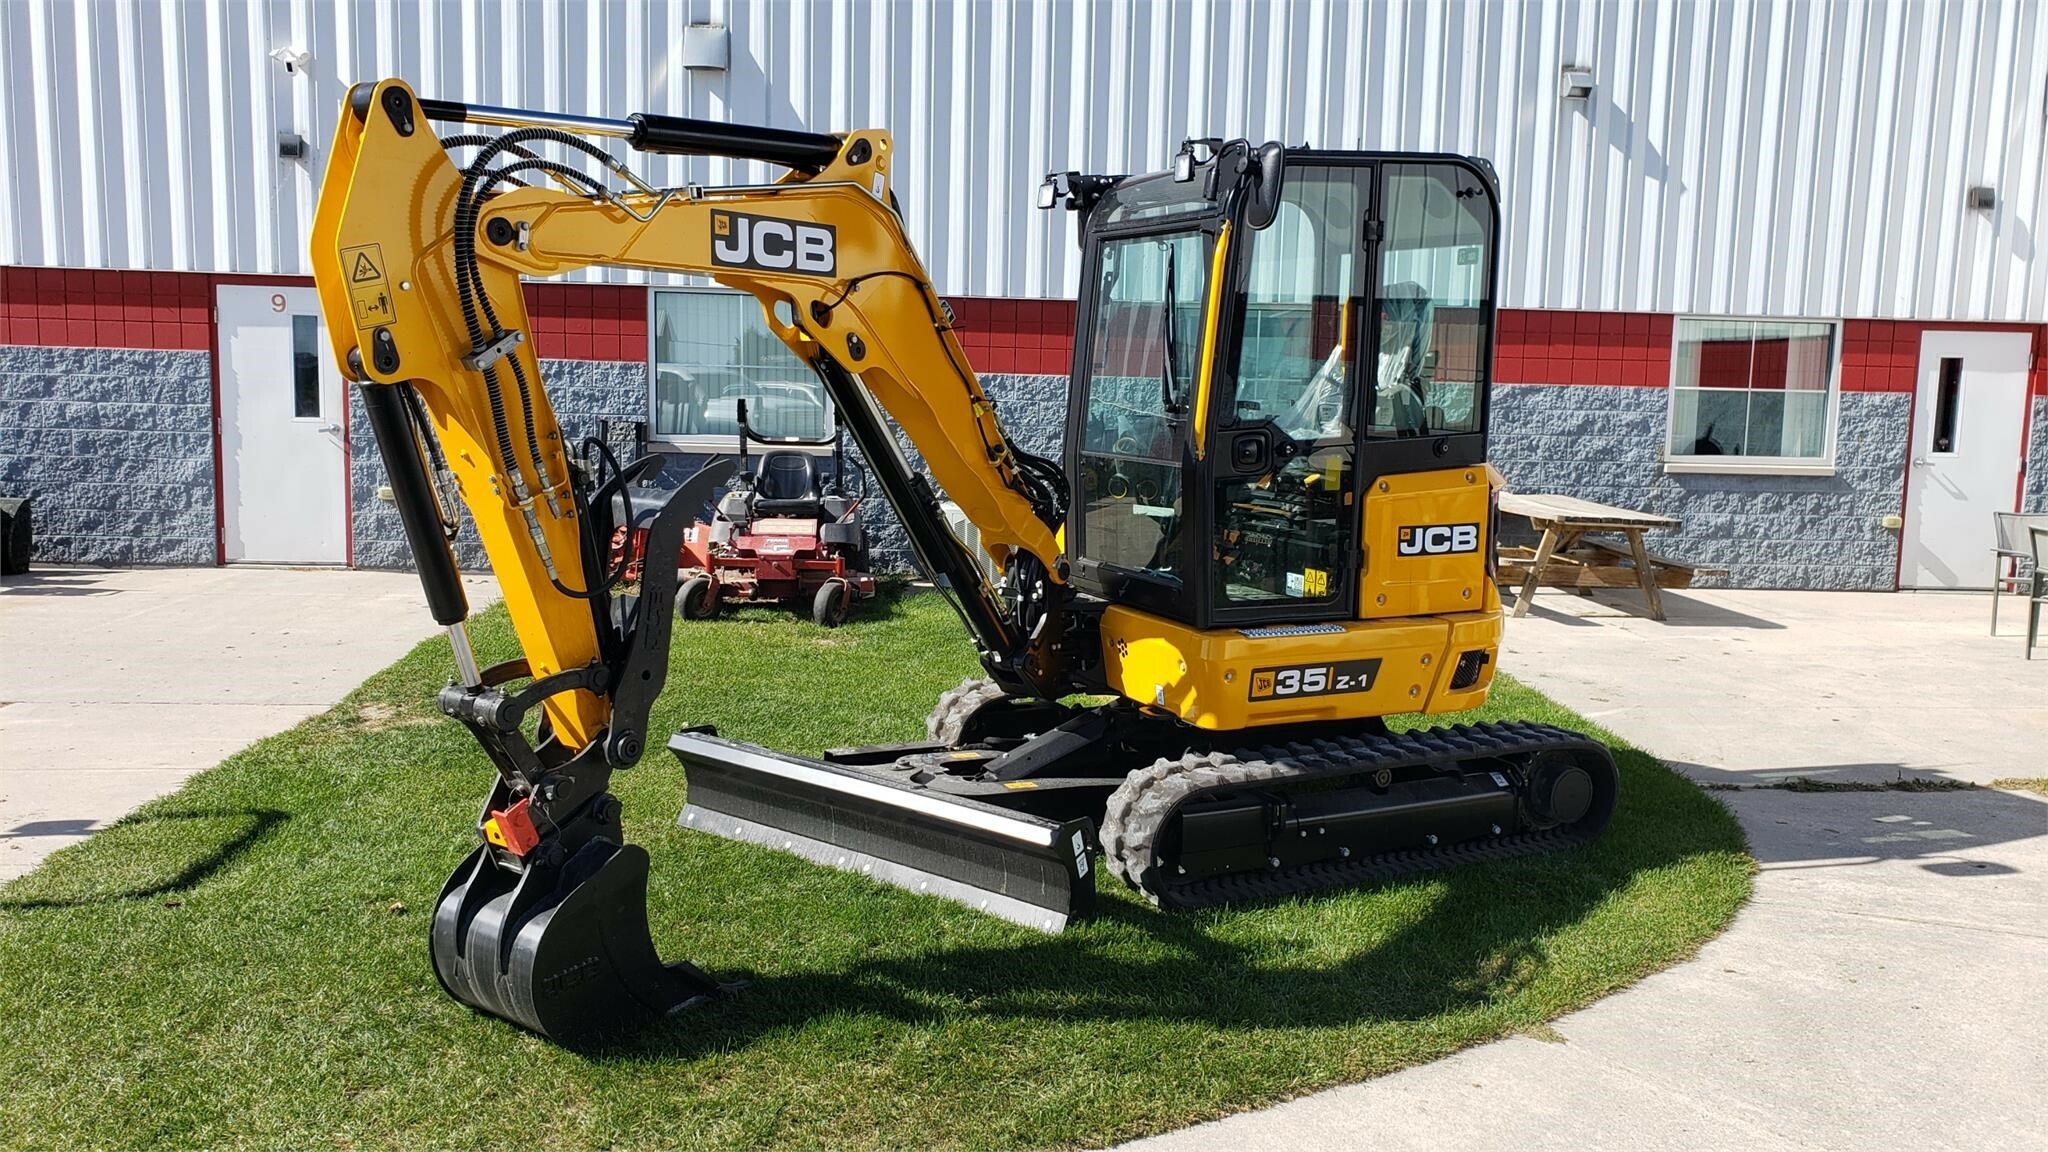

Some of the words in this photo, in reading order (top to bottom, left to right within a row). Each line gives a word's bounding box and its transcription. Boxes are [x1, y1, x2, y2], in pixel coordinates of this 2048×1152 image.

[715, 217, 834, 272] JCB
[271, 294, 287, 313] 9
[1400, 525, 1477, 554] JCB
[1275, 667, 1327, 695] 35
[1335, 674, 1368, 690] Z-1
